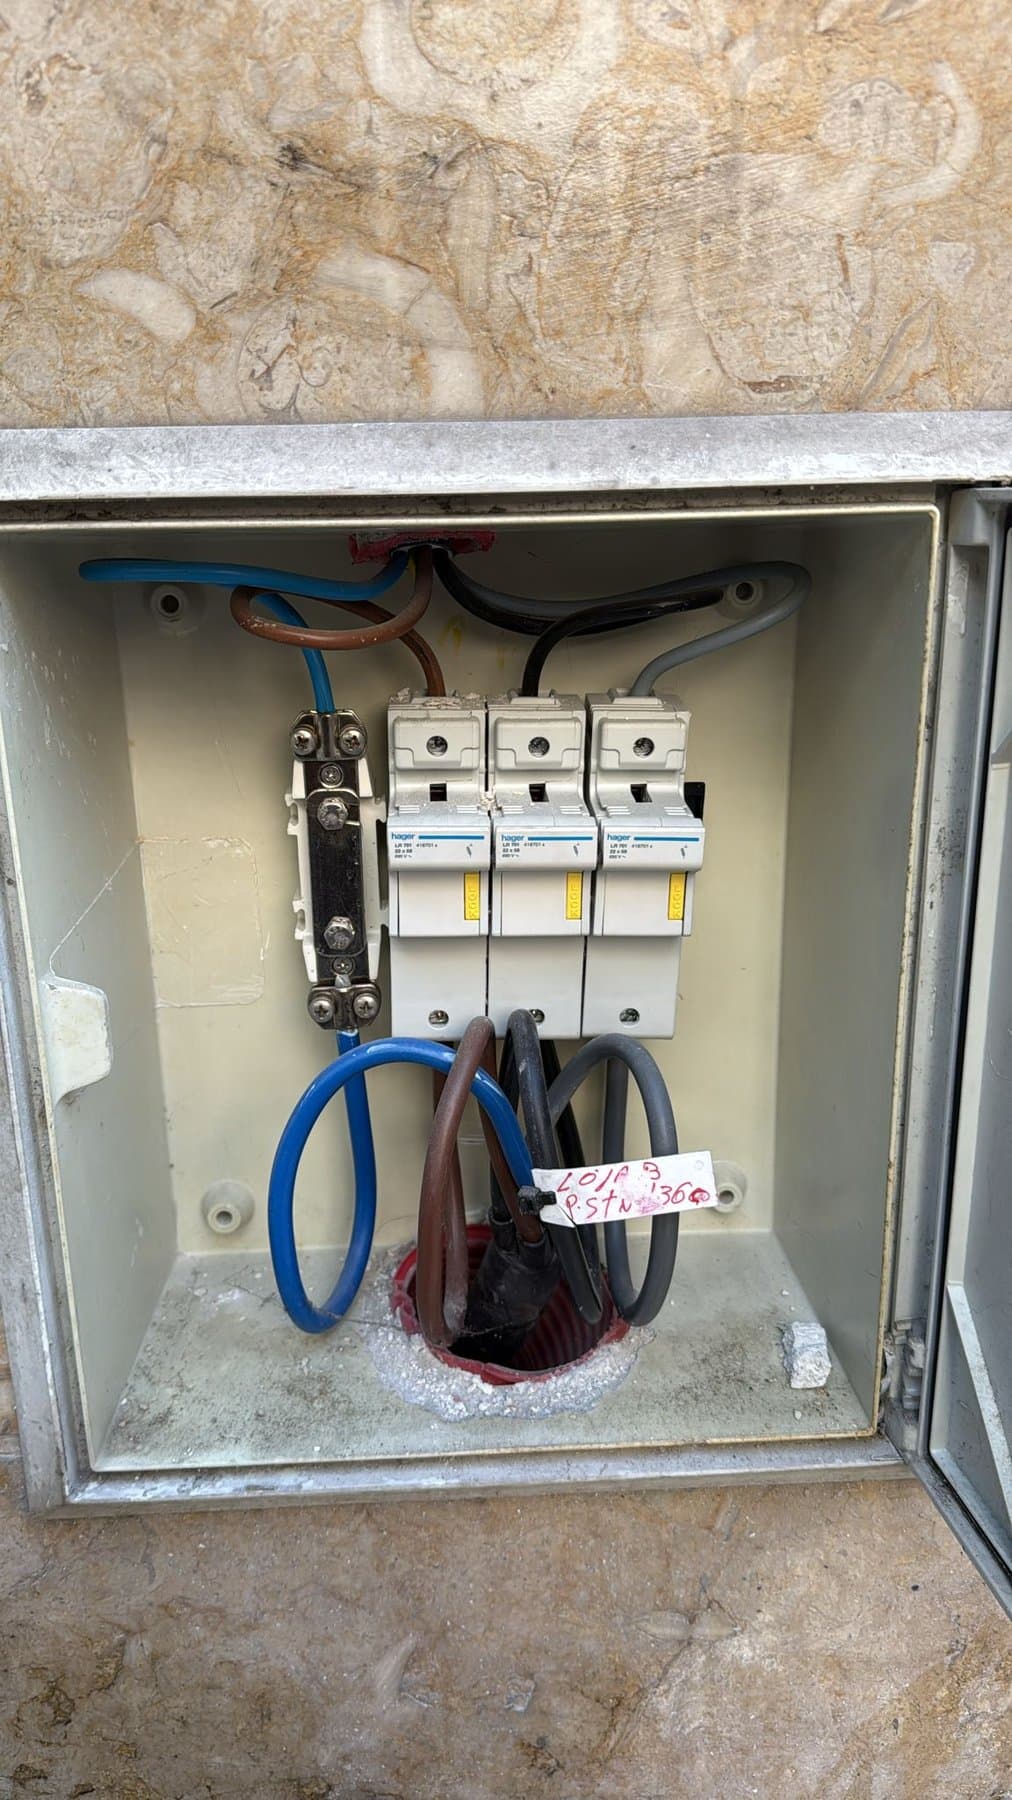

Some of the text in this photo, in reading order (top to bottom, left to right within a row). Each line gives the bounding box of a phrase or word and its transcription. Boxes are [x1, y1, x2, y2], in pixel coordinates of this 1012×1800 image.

[392, 832, 414, 841] hager
[501, 834, 524, 842] hager
[607, 833, 630, 842] hager
